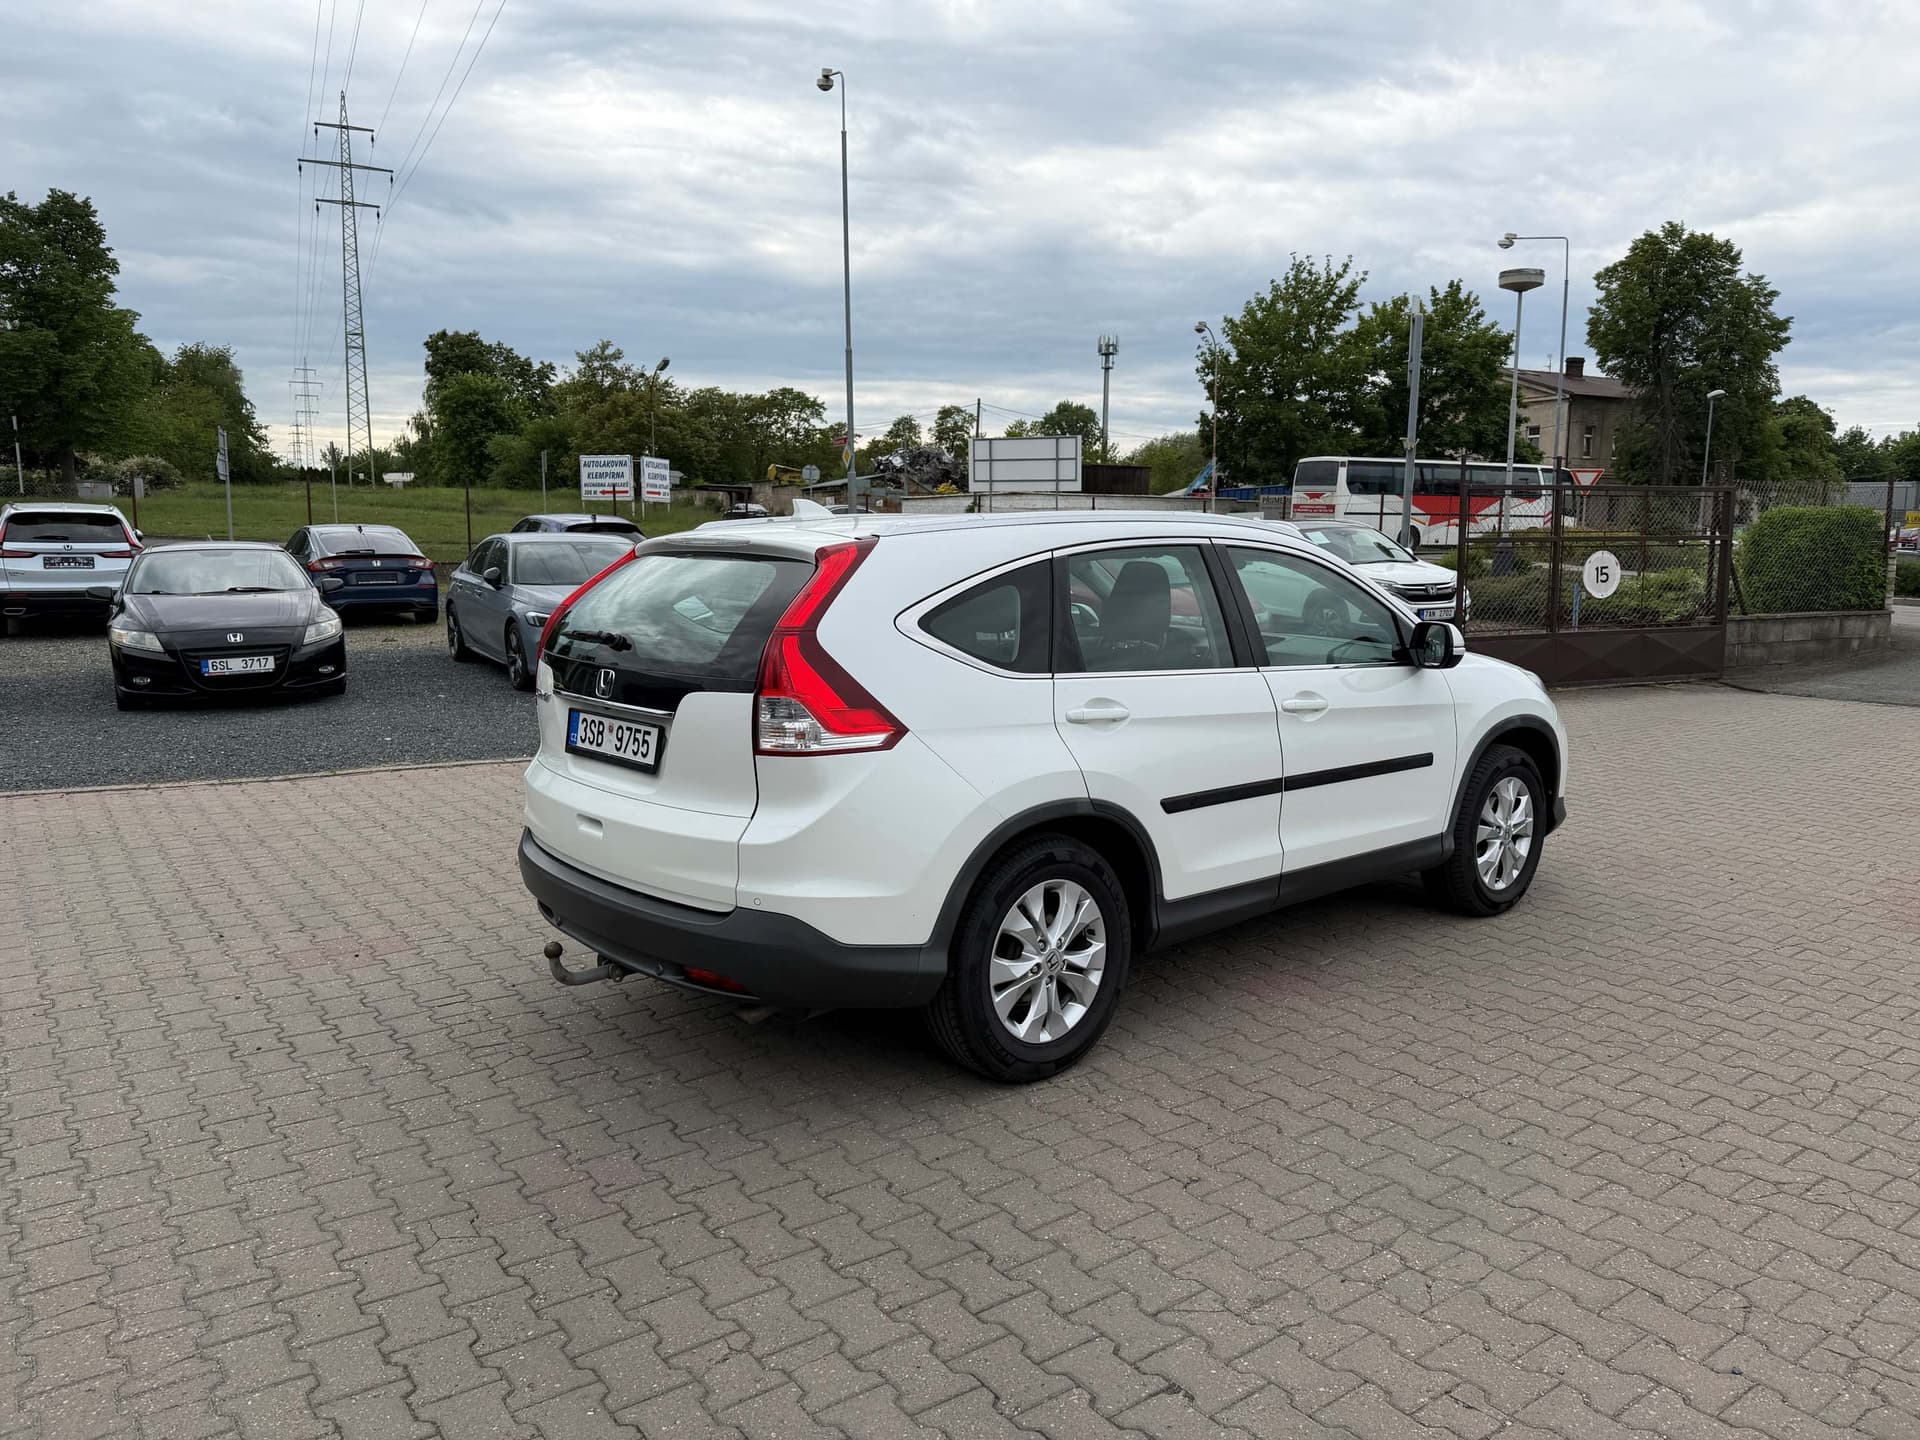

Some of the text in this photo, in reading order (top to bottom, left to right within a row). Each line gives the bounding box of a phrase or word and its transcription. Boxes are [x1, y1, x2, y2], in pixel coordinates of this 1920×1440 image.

[583, 460, 628, 469] AUTOLAKOVNA
[587, 469, 625, 480] KLEMPÍRNA
[1595, 565, 1609, 584] 15
[211, 660, 233, 671] 6SL
[241, 657, 269, 669] 3717
[580, 717, 651, 758] 3SB 9755
